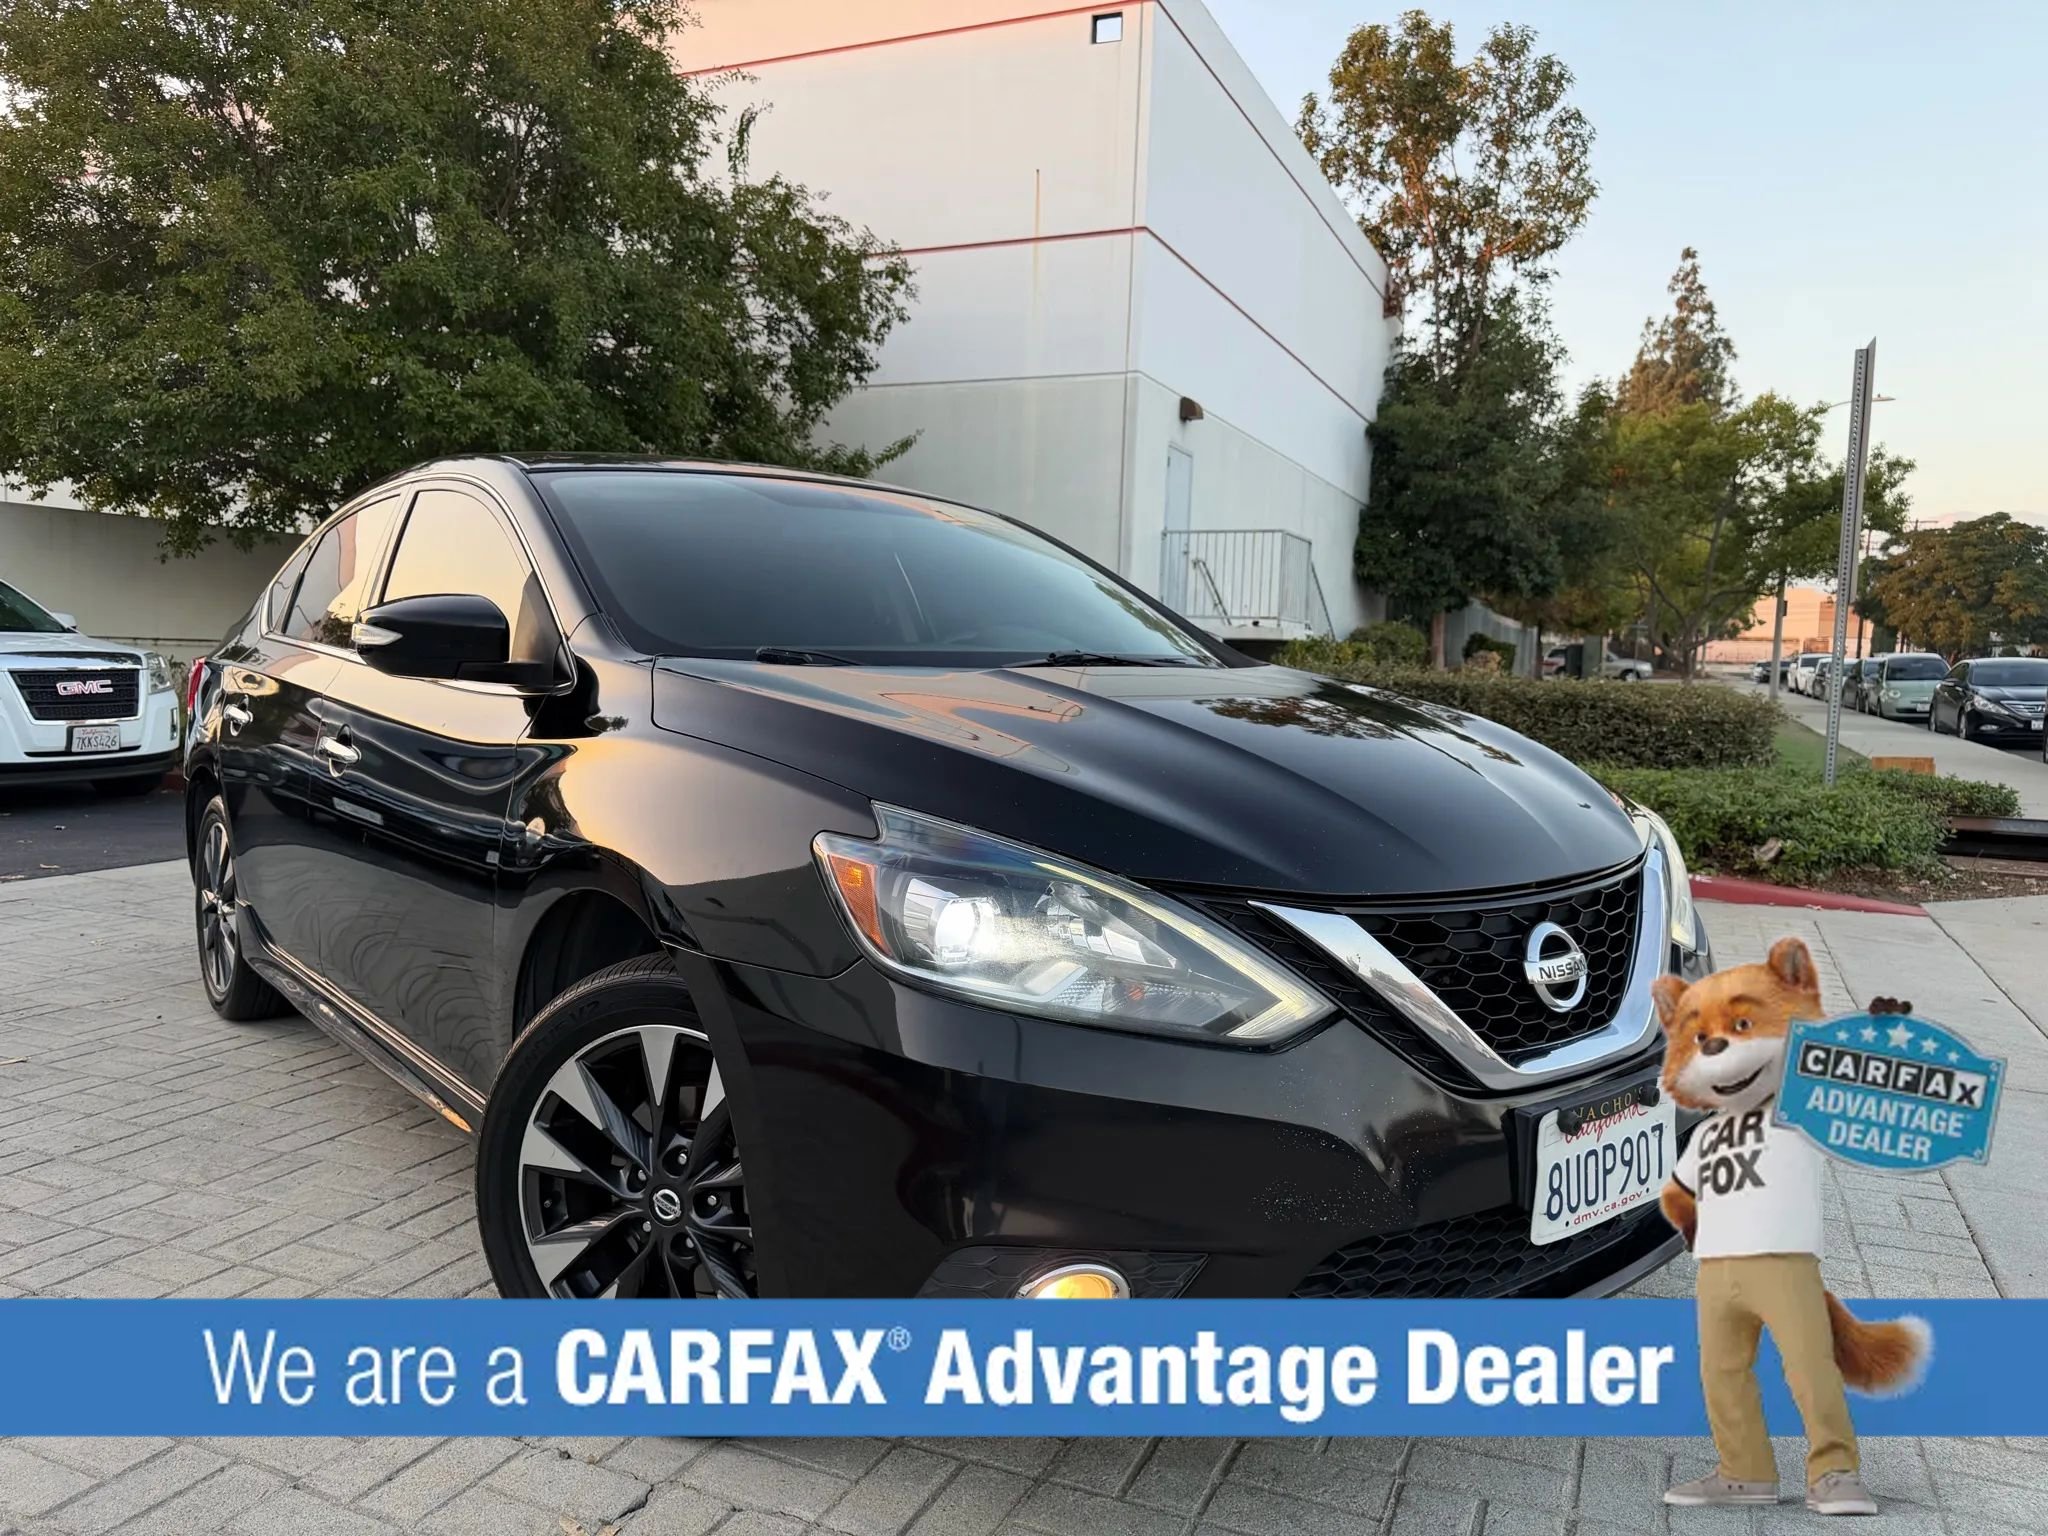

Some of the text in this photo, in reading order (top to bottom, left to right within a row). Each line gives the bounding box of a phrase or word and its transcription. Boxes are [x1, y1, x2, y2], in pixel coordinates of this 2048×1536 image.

[56, 679, 114, 696] GMC
[1539, 956, 1588, 980] NISSAN
[1573, 1190, 1643, 1226] dmv.ca.gov
